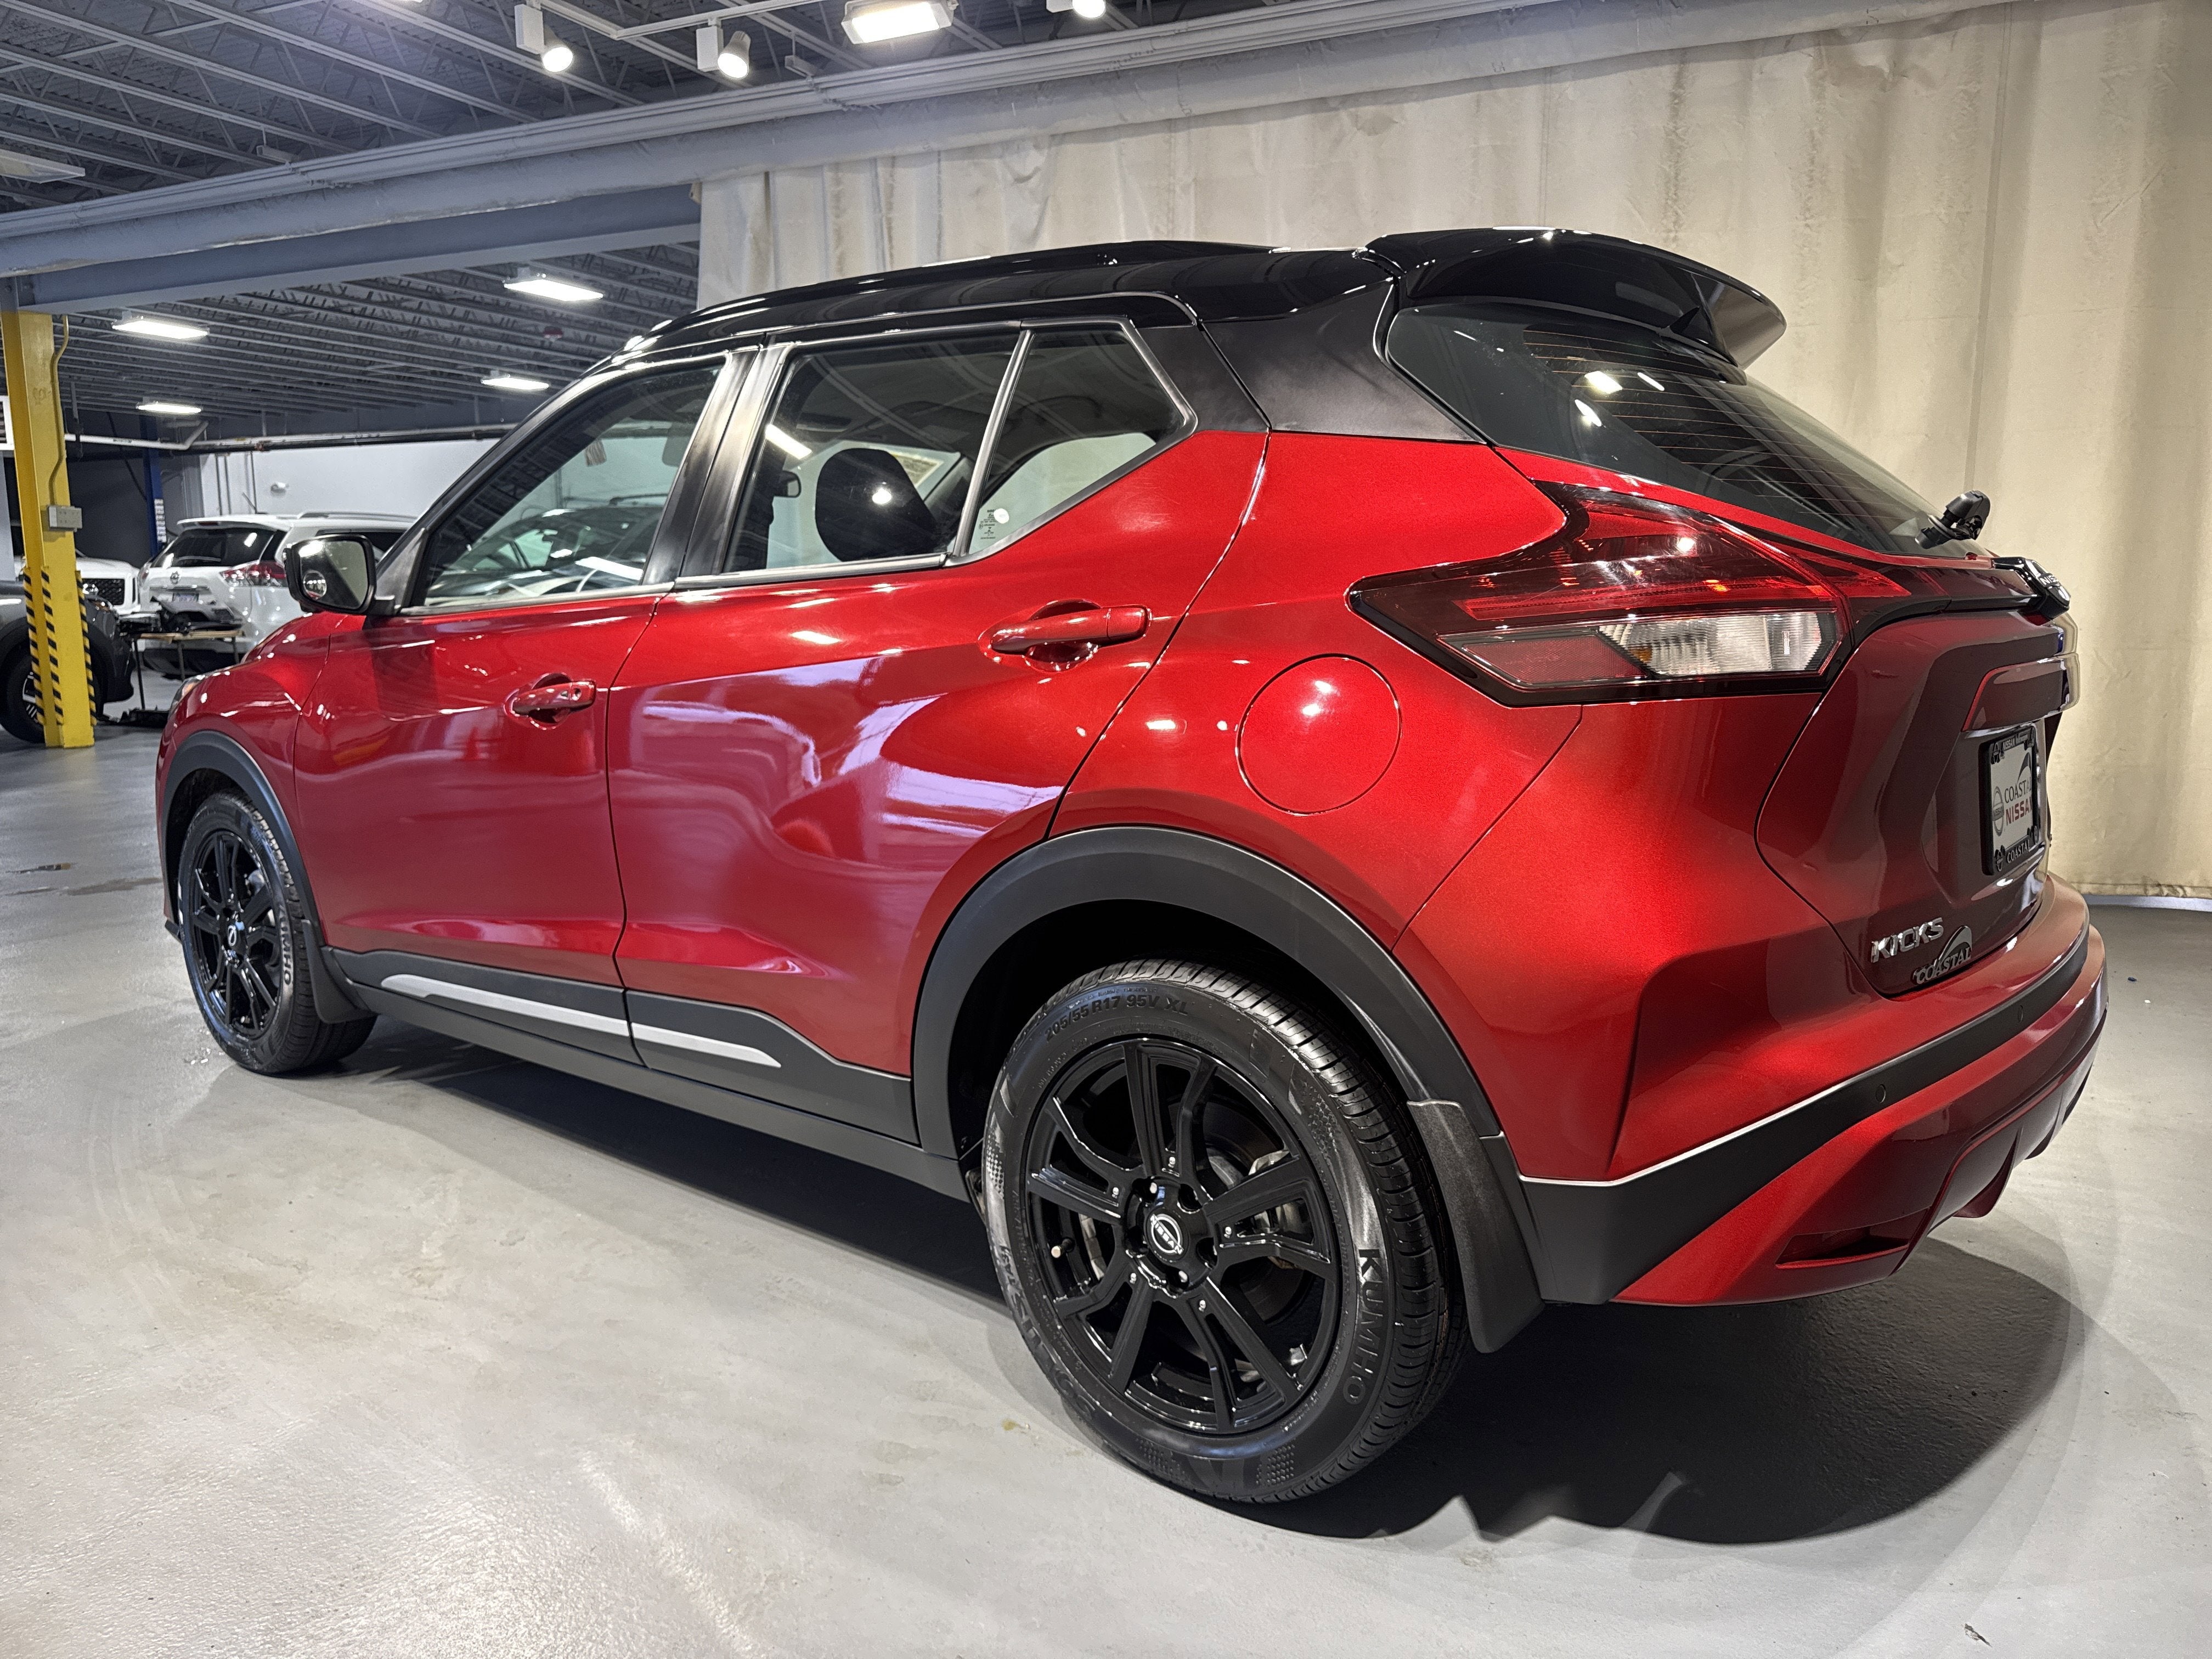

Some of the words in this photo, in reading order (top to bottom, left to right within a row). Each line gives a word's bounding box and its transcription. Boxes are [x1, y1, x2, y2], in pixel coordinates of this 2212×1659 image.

[2004, 776, 2032, 804] COASTAL
[2007, 839, 2031, 864] COASTAL
[1871, 917, 1944, 963] KICKS
[1915, 946, 1972, 985] COASTAL
[1126, 994, 1161, 1009] 95V
[1164, 996, 1189, 1016] XL
[1150, 1214, 1183, 1255] NISSAN
[1342, 1249, 1384, 1405] KUMHO
